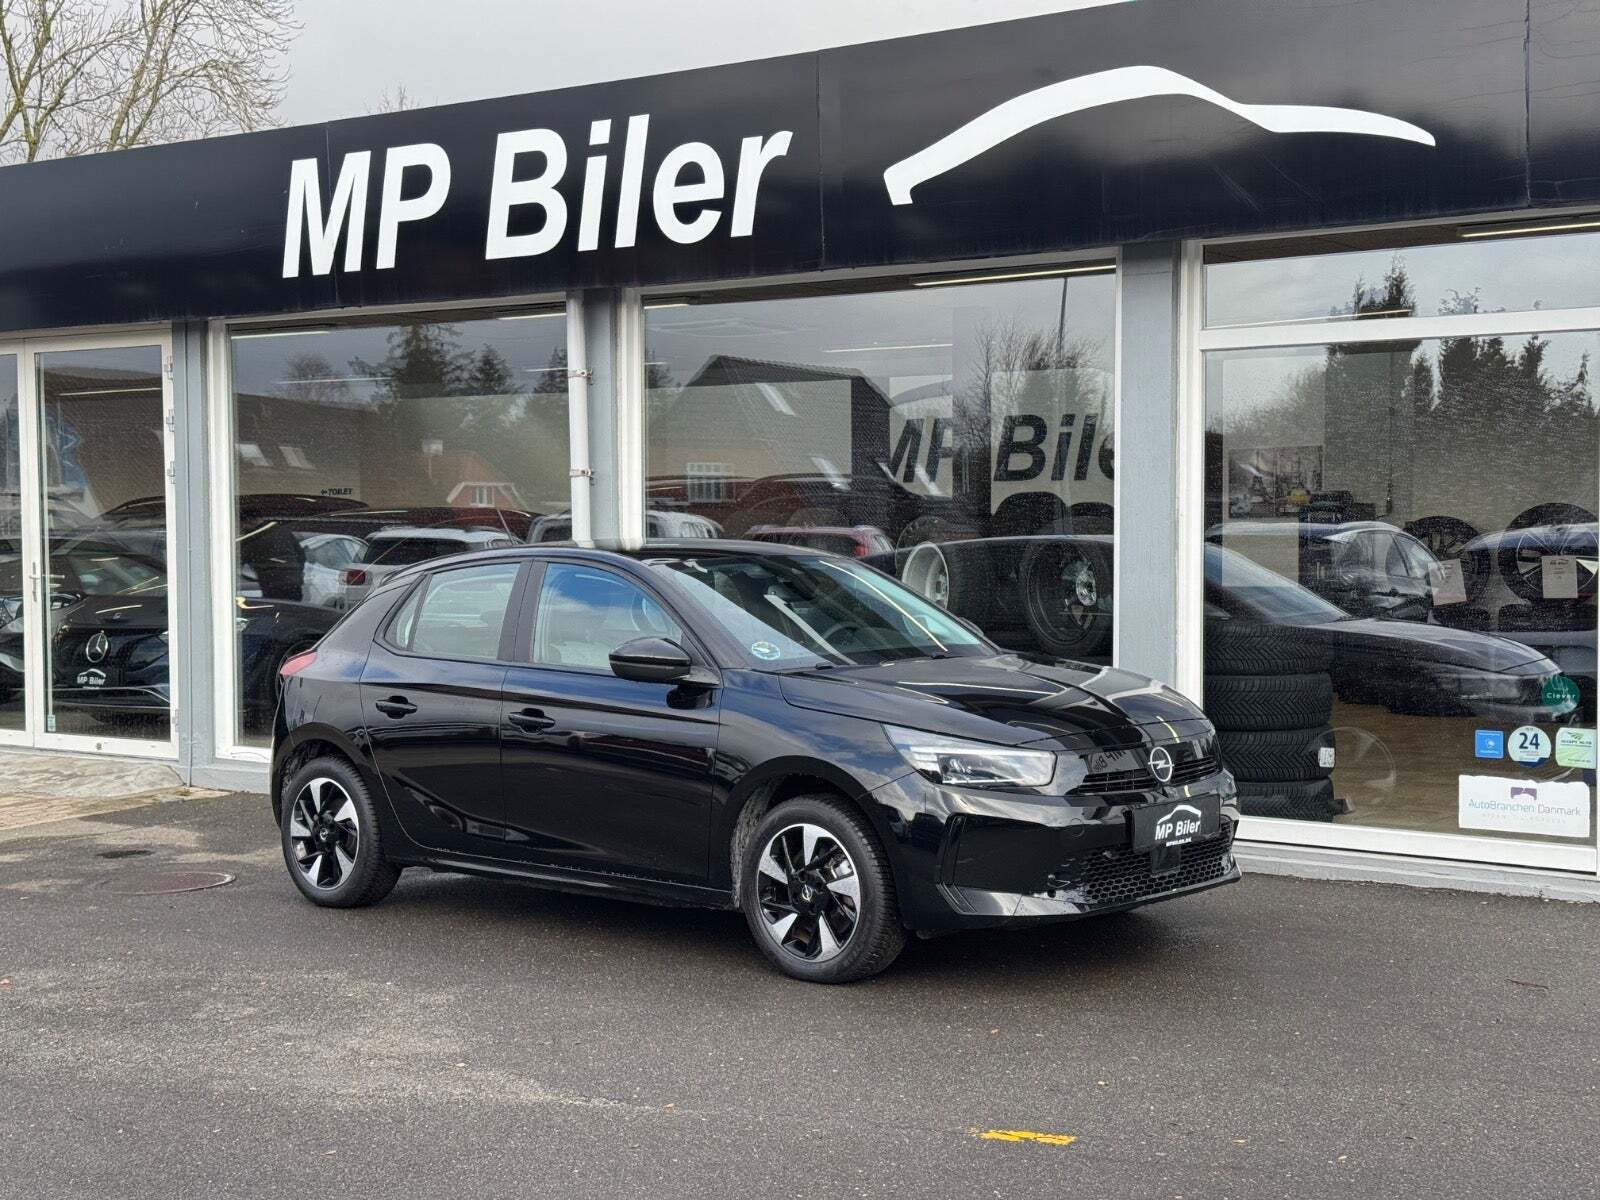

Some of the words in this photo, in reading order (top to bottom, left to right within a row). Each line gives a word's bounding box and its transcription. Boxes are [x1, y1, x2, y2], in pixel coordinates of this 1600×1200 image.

[282, 142, 452, 279] MP
[485, 113, 794, 261] Biler
[89, 676, 105, 685] Biler
[1518, 732, 1540, 750] 24
[1468, 798, 1535, 813] AutoBranchen
[1537, 803, 1581, 816] Danmark
[1155, 823, 1173, 841] MP
[1175, 819, 1201, 837] Biler
